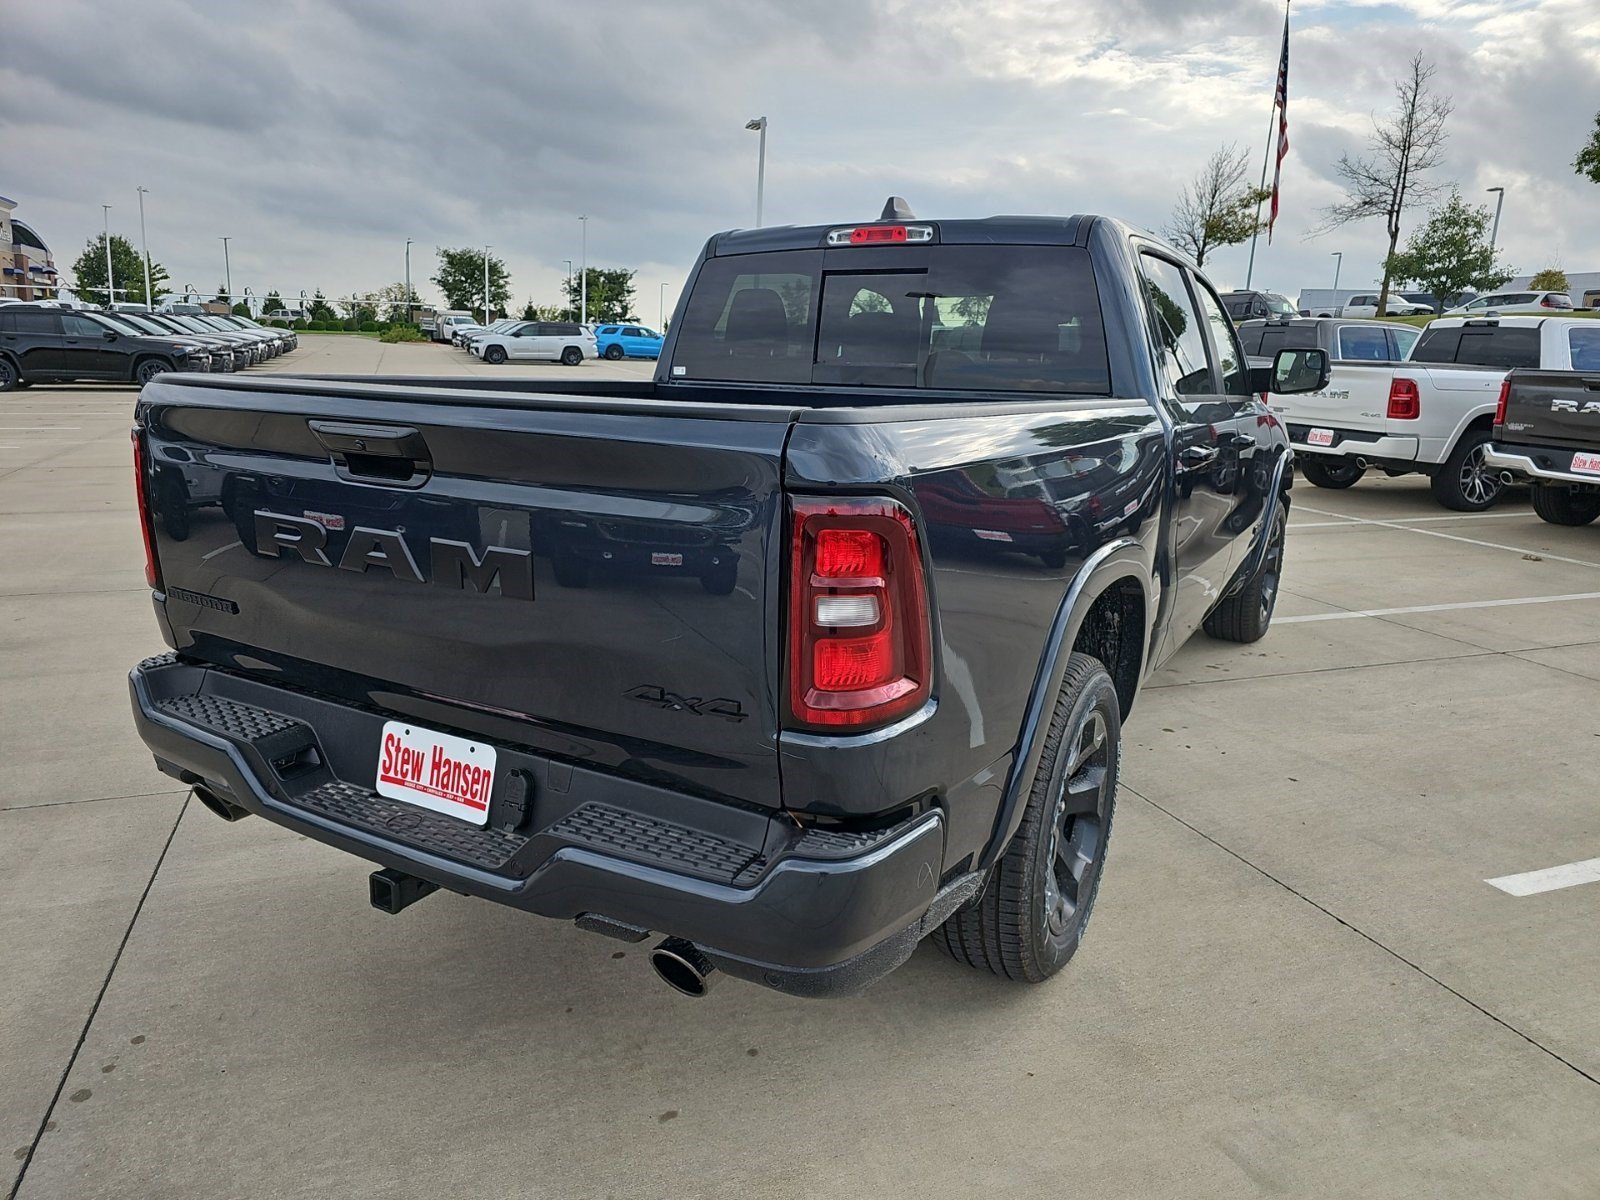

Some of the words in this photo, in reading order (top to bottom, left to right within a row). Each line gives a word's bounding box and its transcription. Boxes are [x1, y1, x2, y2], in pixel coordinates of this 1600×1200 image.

[254, 510, 536, 601] RAM
[382, 733, 425, 782] Stew
[429, 745, 492, 803] Hansen
